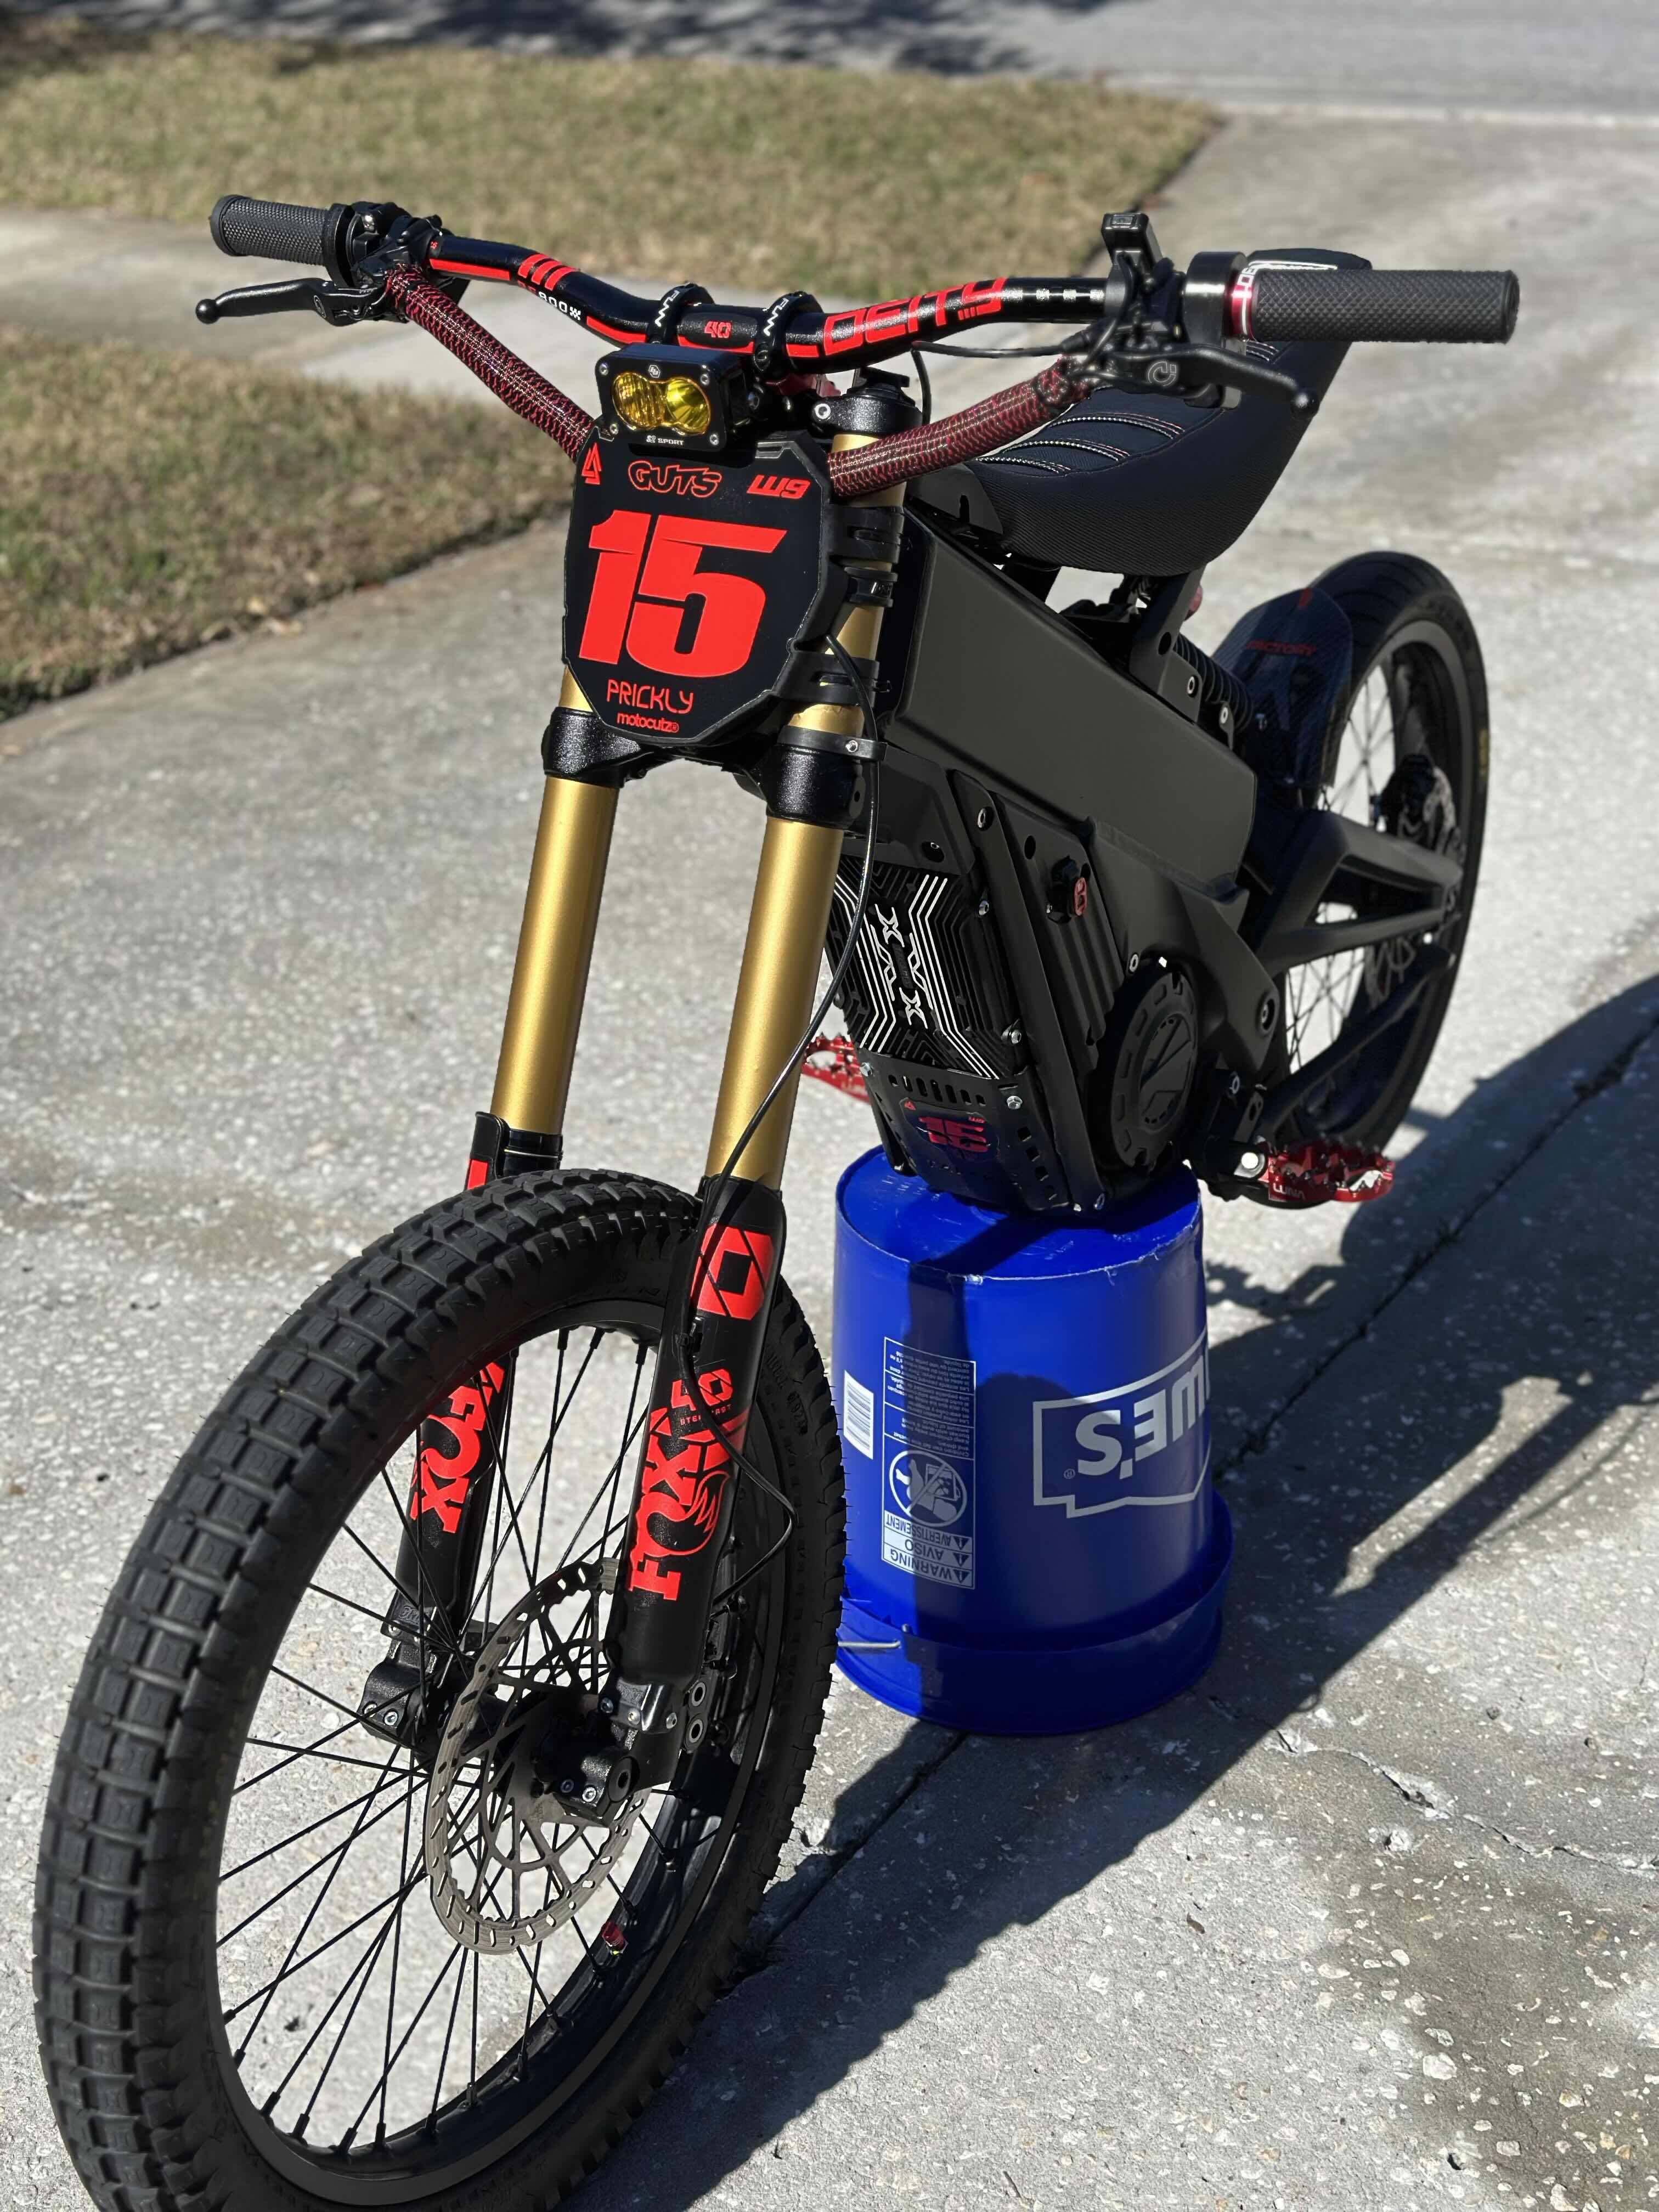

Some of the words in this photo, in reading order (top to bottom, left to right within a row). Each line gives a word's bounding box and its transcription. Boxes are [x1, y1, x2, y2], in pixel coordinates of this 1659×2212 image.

[825, 277, 1007, 356] DEITY
[658, 437, 685, 445] SPORT
[628, 460, 723, 498] GUTS
[579, 509, 788, 678] 15
[606, 679, 695, 714] PRICKLY
[671, 1368, 733, 1411] 40
[629, 1432, 730, 1601] FOX
[885, 1513, 952, 1547] AVERTISSEMENT
[890, 1548, 953, 1575] WARNING
[905, 1538, 944, 1561] AVISO
